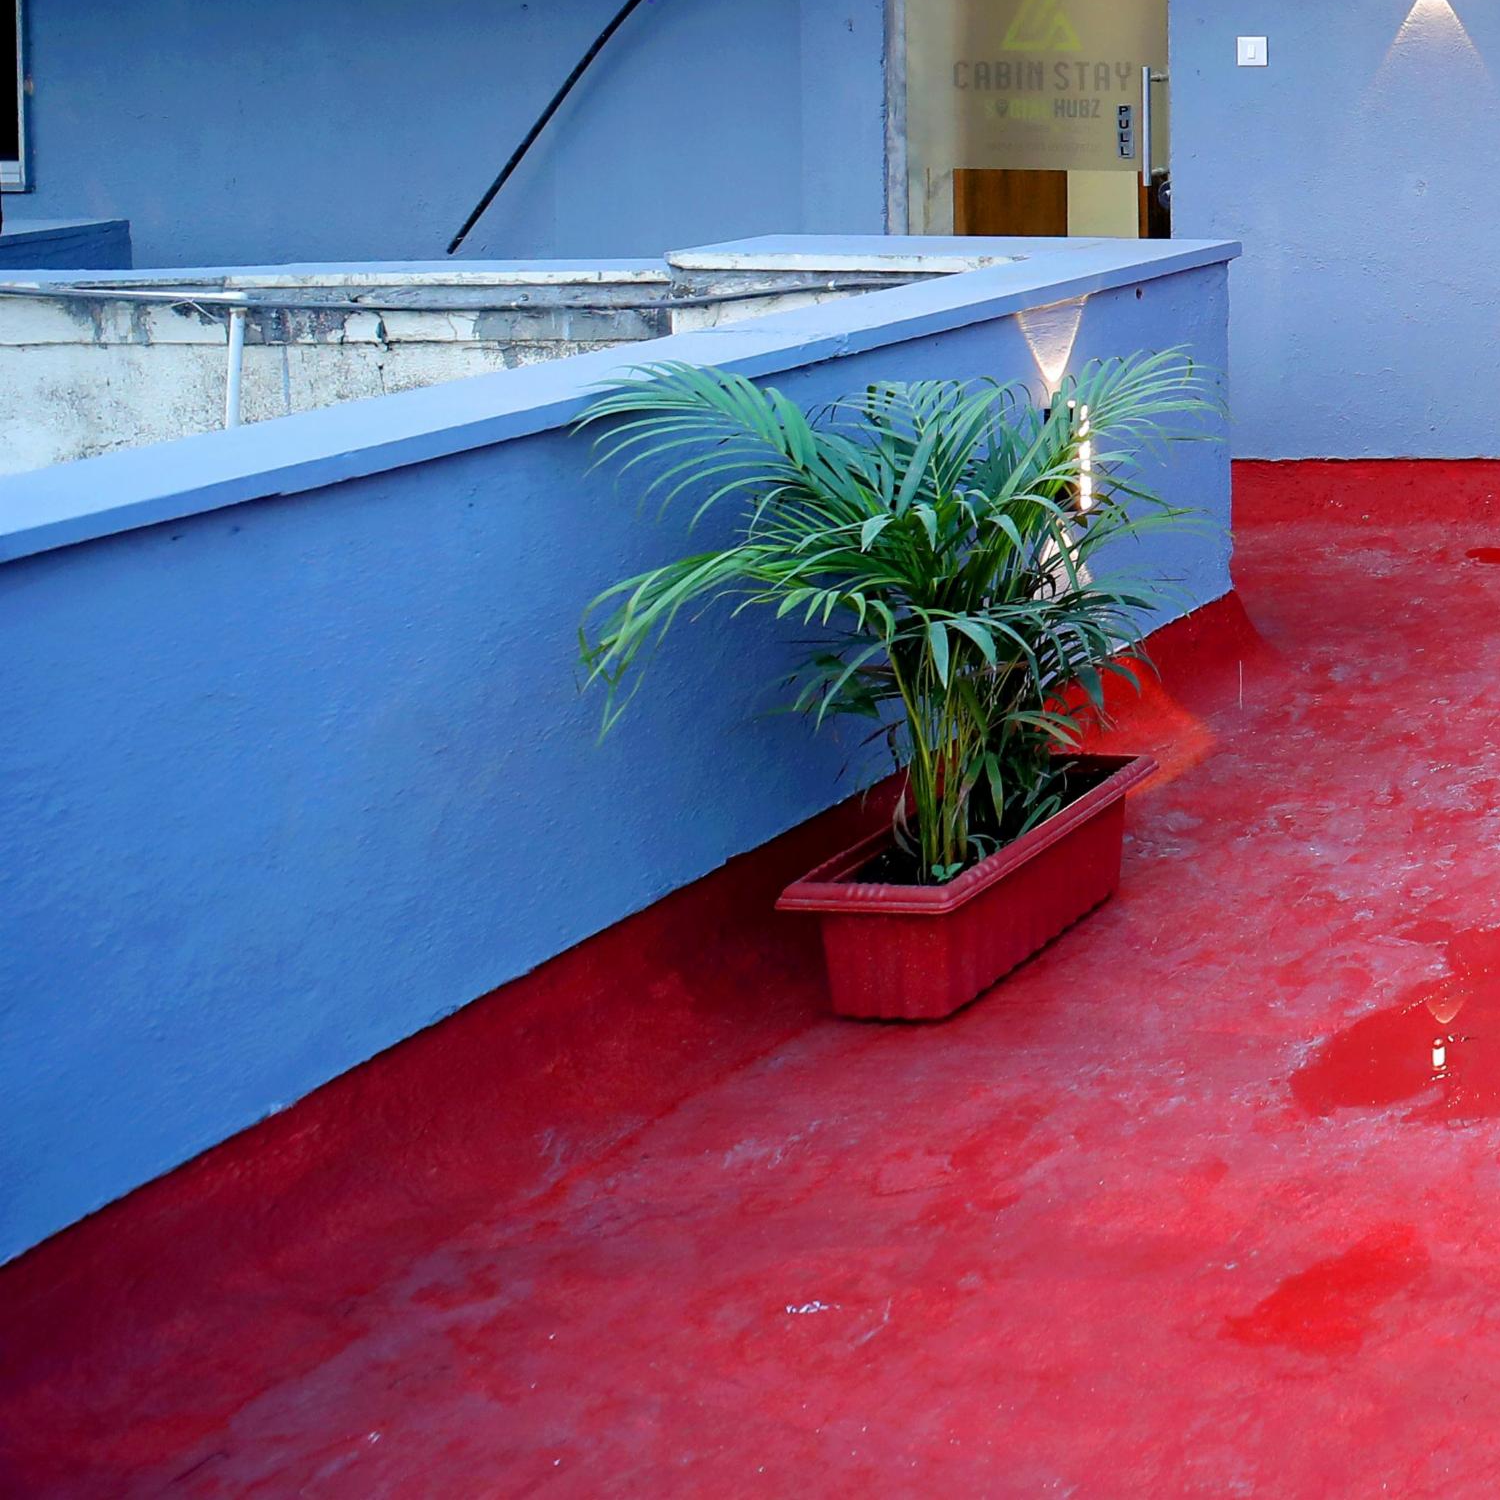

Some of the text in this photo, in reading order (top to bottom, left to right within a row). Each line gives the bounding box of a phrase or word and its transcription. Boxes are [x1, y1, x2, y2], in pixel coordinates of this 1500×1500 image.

[953, 61, 1132, 91] CABIN STAY
[1054, 98, 1101, 118] HUBZ
[1118, 105, 1130, 156] PULL
